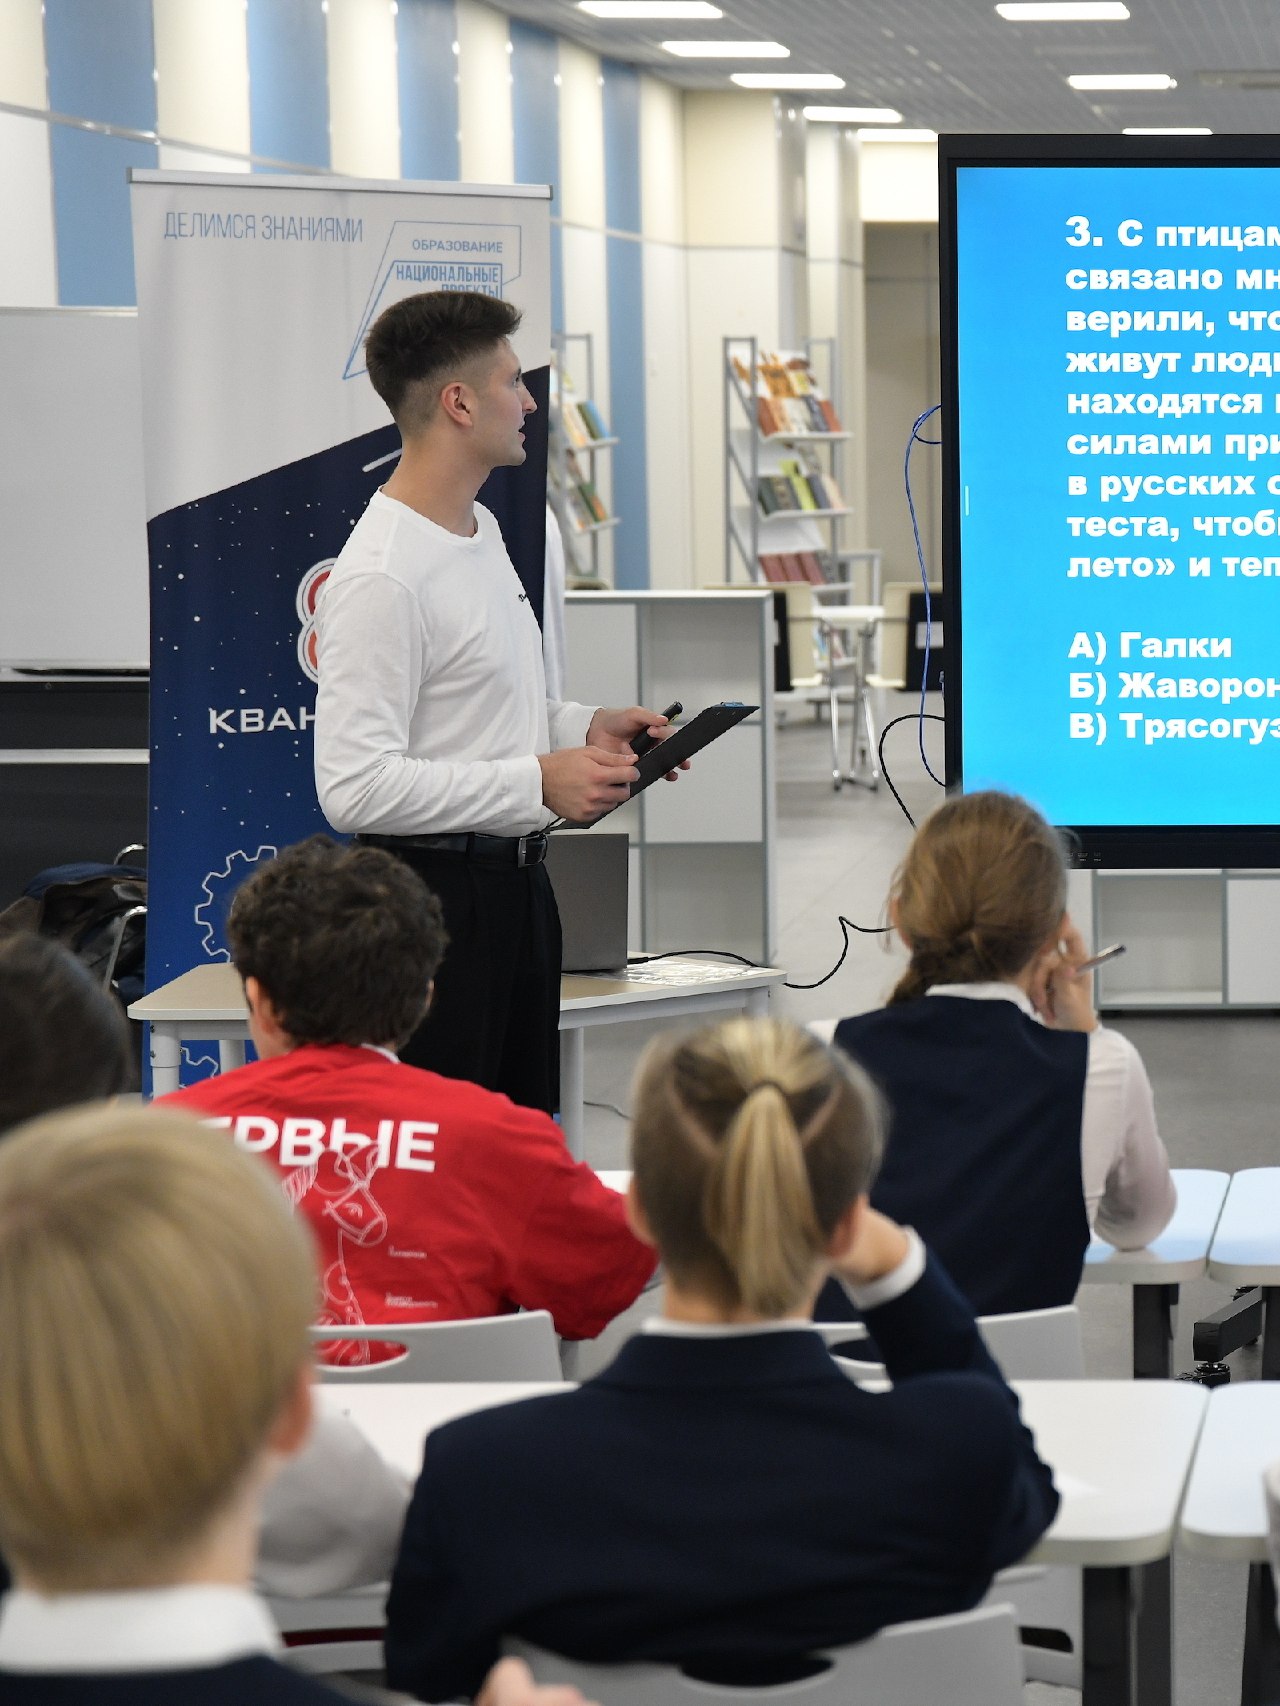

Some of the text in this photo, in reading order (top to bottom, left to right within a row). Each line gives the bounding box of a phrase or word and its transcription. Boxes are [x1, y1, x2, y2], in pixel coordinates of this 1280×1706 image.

[164, 212, 363, 243] ДЕЛИМСЯ ЗНАНИЯМИ
[1065, 215, 1103, 247] 3.
[1117, 219, 1144, 247] С
[411, 239, 504, 254] ОБРАЗОВАНИЕ
[396, 265, 499, 283] НАЦИОНАЛЬНЫЕ
[1065, 268, 1223, 290] связано
[1066, 310, 1215, 338] верили,
[1065, 352, 1182, 380] живут
[1067, 393, 1263, 419] находятся
[1066, 433, 1212, 455] силами
[1068, 475, 1088, 496] в
[1100, 475, 1256, 503] русских
[1066, 516, 1180, 543] теста,
[1066, 556, 1176, 578] лето»
[1189, 556, 1211, 577] и
[1067, 631, 1232, 666] А) Галки
[1069, 671, 1107, 706] Б)
[1069, 712, 1107, 746] В)
[198, 1115, 439, 1173] РВЫЕ
